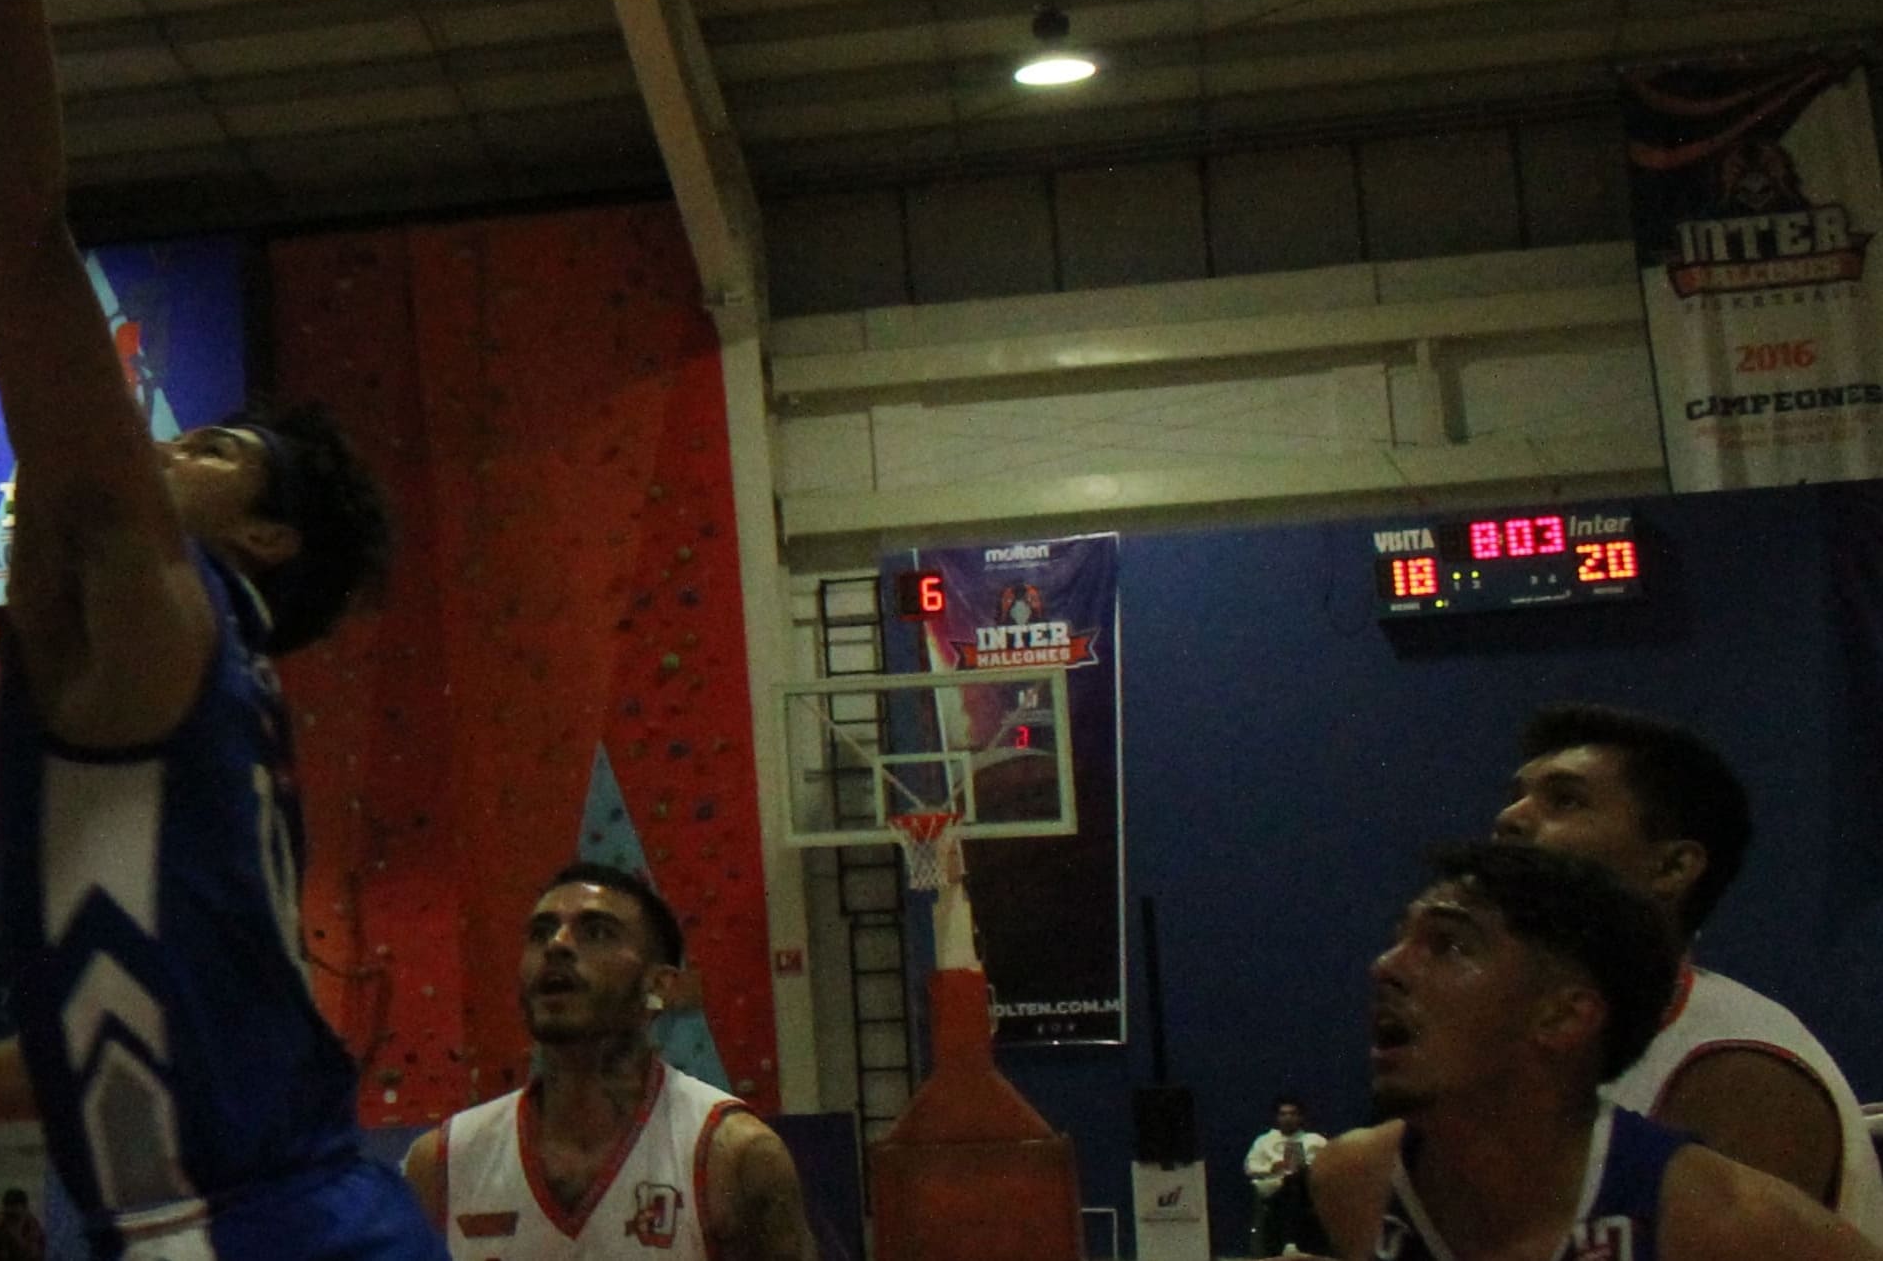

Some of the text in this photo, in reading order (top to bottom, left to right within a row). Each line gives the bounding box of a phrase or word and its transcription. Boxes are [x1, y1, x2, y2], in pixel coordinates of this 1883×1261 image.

[1736, 340, 1815, 372] 2016
[1570, 515, 1632, 537] Inter
[983, 545, 1050, 563] molten
[1574, 539, 1639, 583] 20
[1391, 556, 1439, 598] 18
[919, 575, 944, 613] 6
[976, 621, 1071, 652] INTER
[976, 647, 1071, 668] HALCONES
